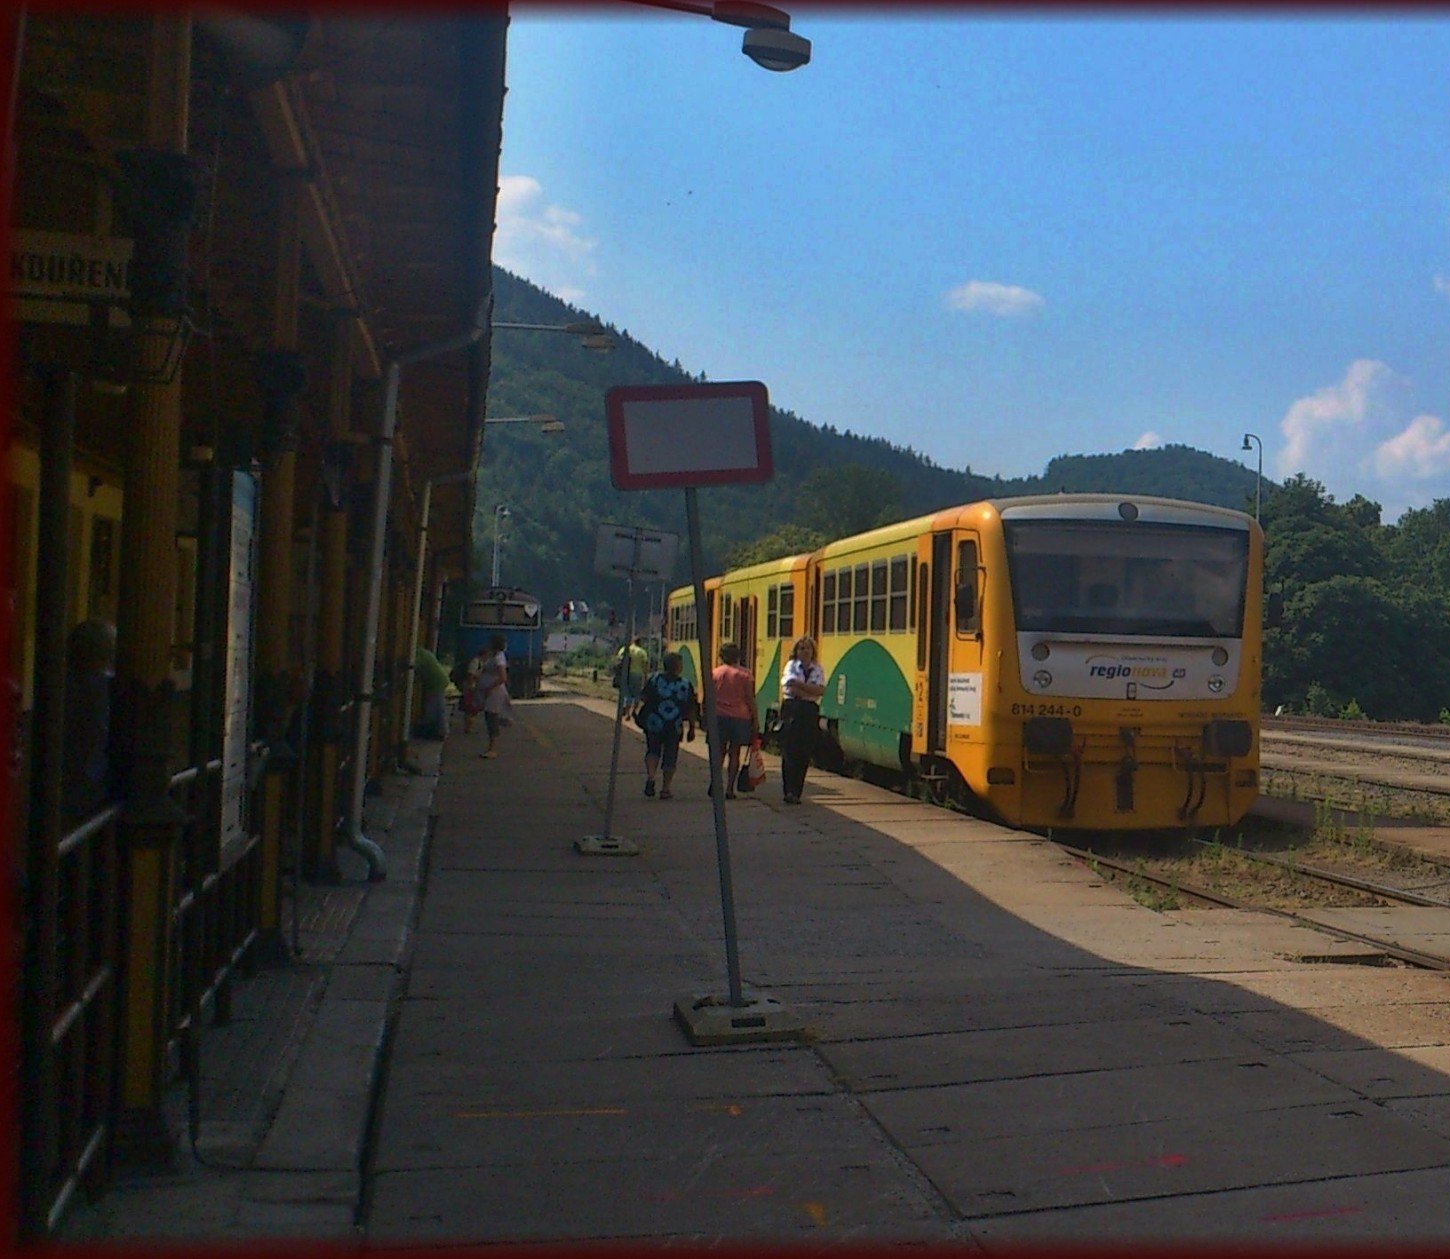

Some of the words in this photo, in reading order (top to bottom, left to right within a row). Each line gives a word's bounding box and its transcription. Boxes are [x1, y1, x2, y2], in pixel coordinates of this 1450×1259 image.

[1090, 664, 1168, 679] regionova
[1011, 702, 1035, 716] 814
[1038, 703, 1082, 718] 244-0
